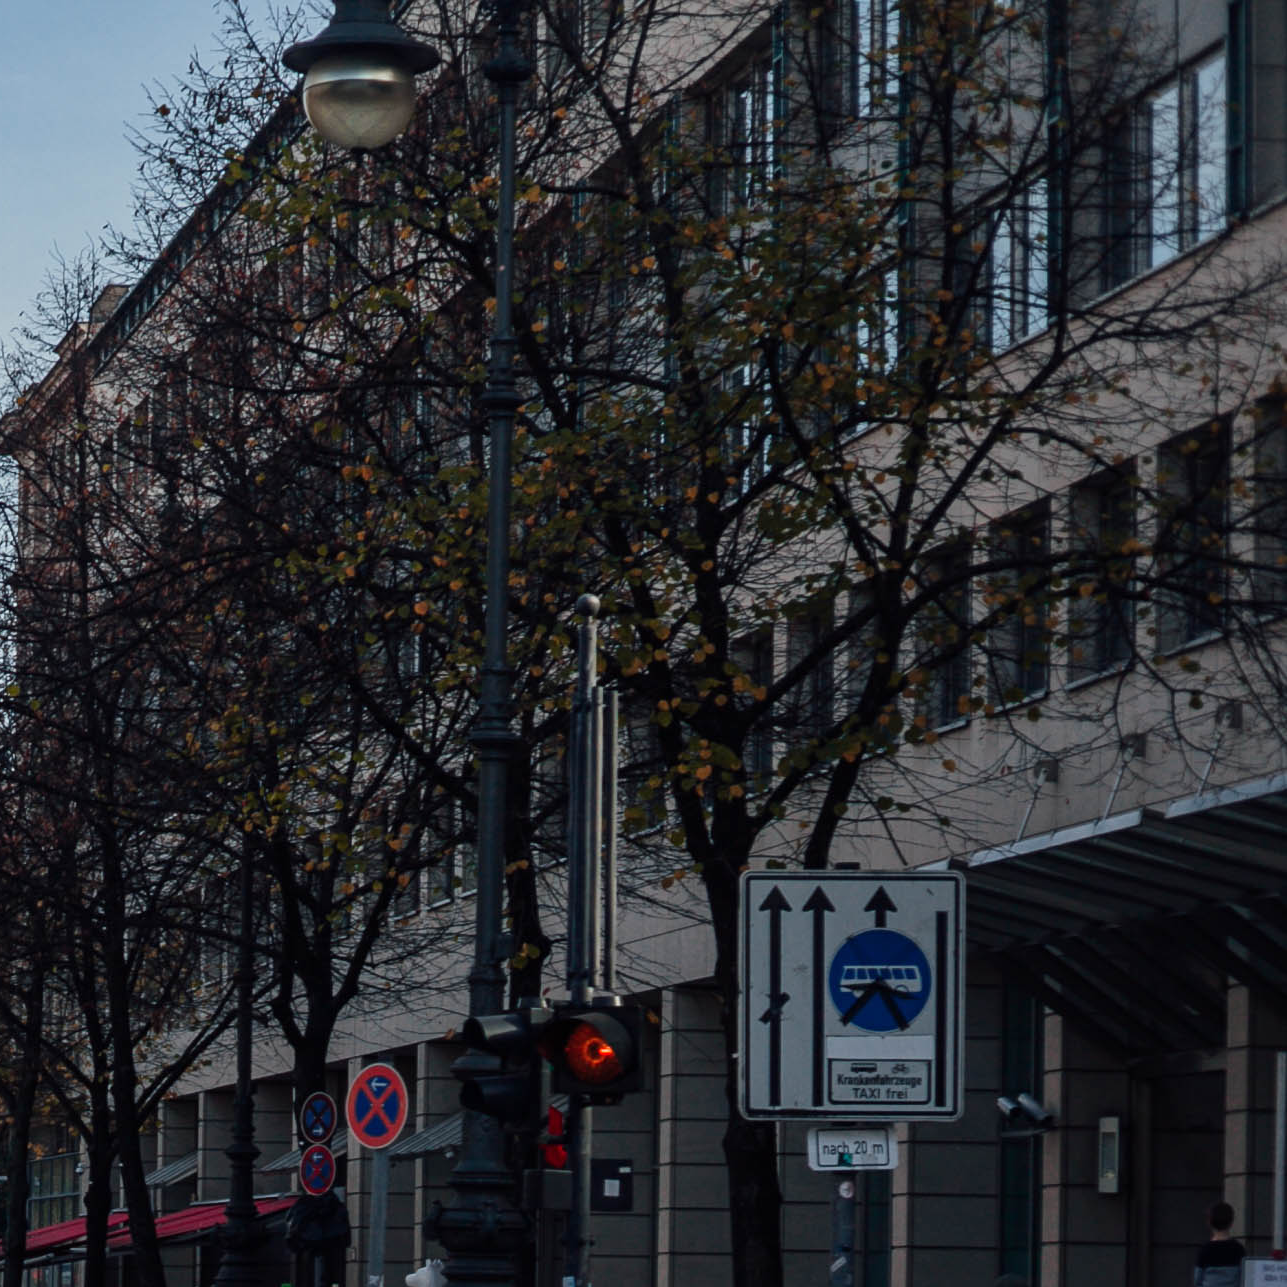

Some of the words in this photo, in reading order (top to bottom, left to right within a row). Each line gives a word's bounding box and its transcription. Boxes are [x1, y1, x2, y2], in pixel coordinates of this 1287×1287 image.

[837, 1073, 923, 1088] Krankenfahrzeuge
[852, 1088, 880, 1099] TAXI
[886, 1087, 908, 1099] frei
[822, 1141, 850, 1155] nach
[854, 1140, 868, 1154] 20
[873, 1143, 884, 1153] m
